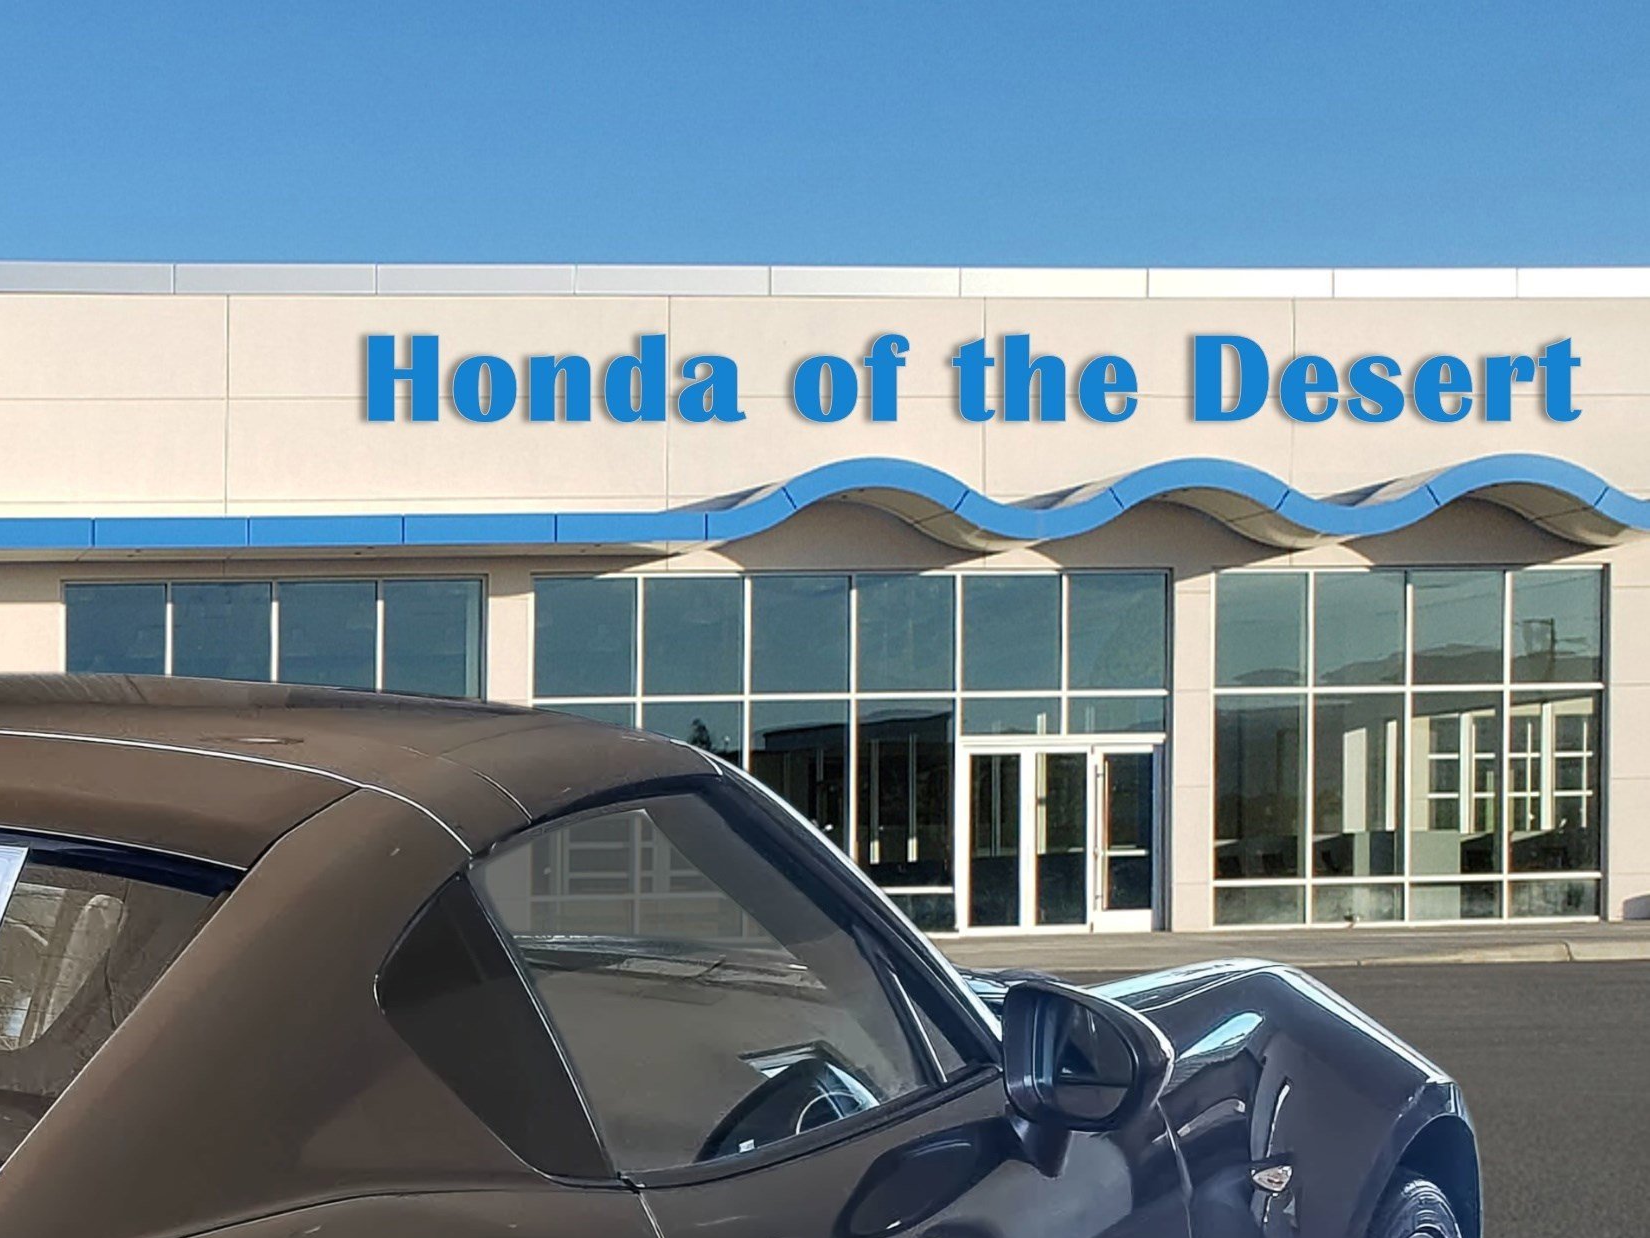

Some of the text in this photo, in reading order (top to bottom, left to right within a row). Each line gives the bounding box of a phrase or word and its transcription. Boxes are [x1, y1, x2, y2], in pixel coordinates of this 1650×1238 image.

[365, 333, 1583, 423] Honda of the Desert
